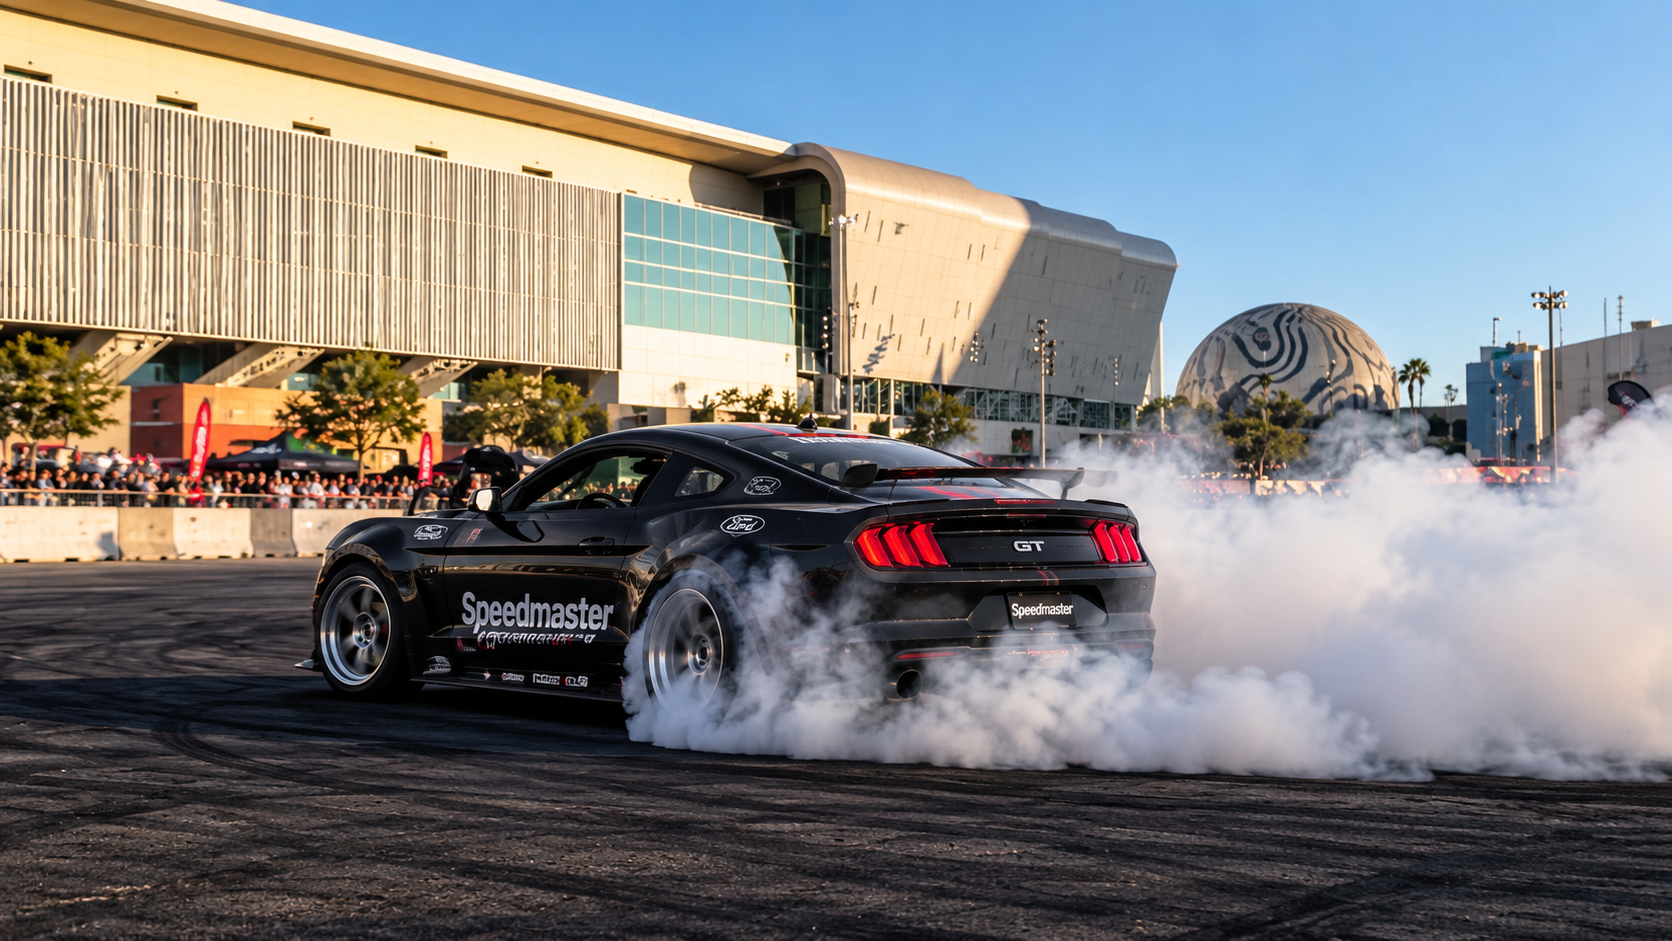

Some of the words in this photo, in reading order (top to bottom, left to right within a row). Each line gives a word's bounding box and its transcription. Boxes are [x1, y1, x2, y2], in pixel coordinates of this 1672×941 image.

[1013, 540, 1045, 552] GT
[461, 591, 615, 634] Speedmaster
[1011, 602, 1074, 620] Speedmaster
